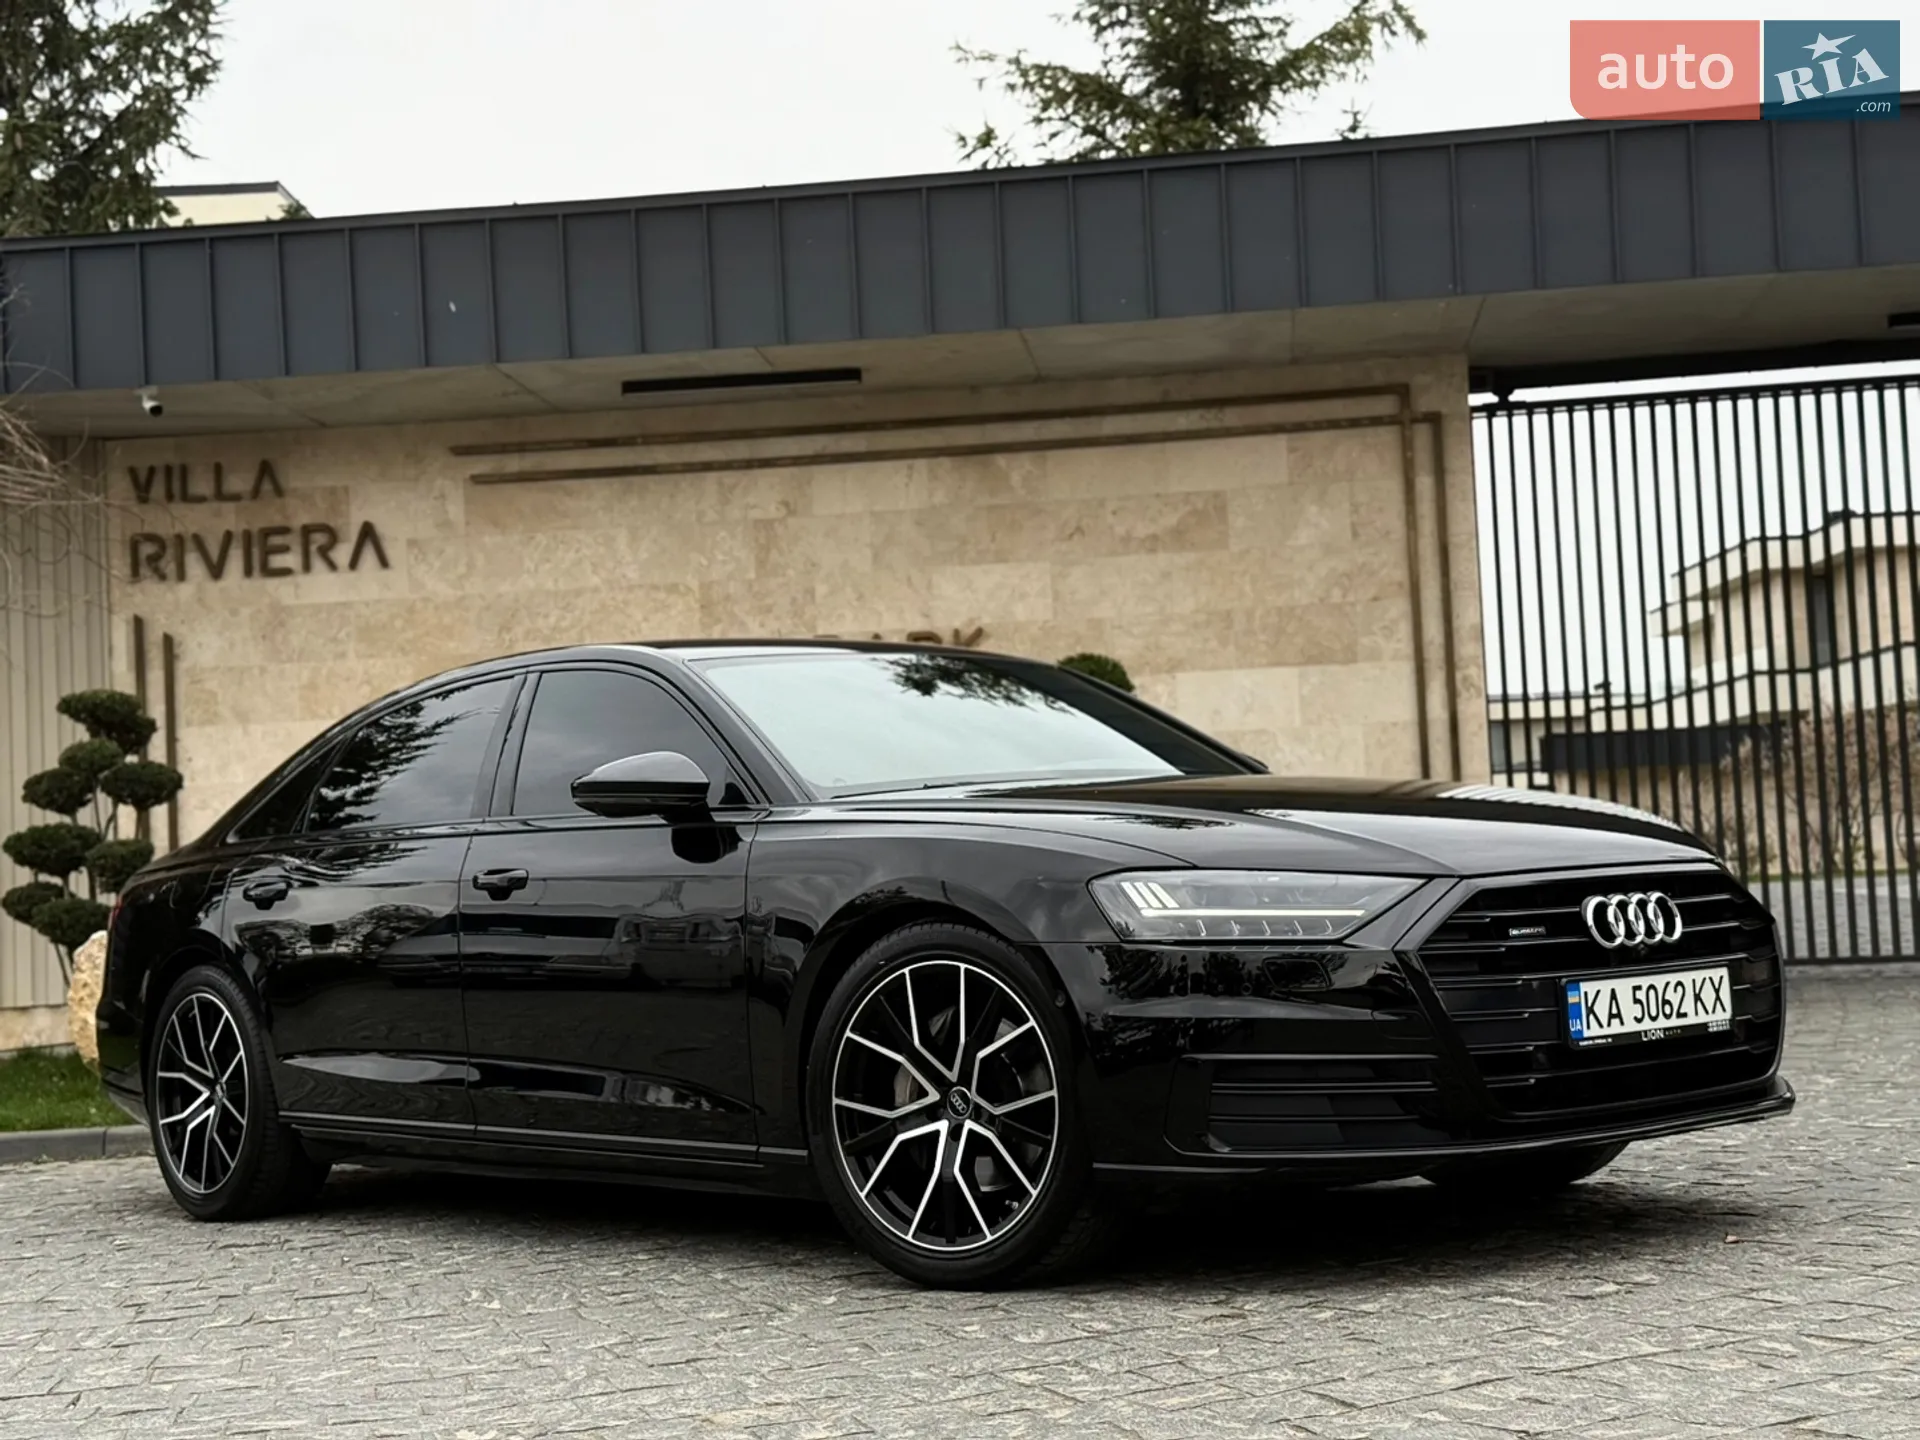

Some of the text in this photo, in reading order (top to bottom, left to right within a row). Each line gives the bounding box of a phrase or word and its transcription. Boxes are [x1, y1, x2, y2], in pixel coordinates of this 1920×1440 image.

[127, 459, 284, 504] VILLA
[129, 520, 390, 582] RIVIERA
[1584, 975, 1727, 1030] KA 5062 KX
[1569, 1019, 1583, 1032] UA
[1641, 1029, 1664, 1041] LION
